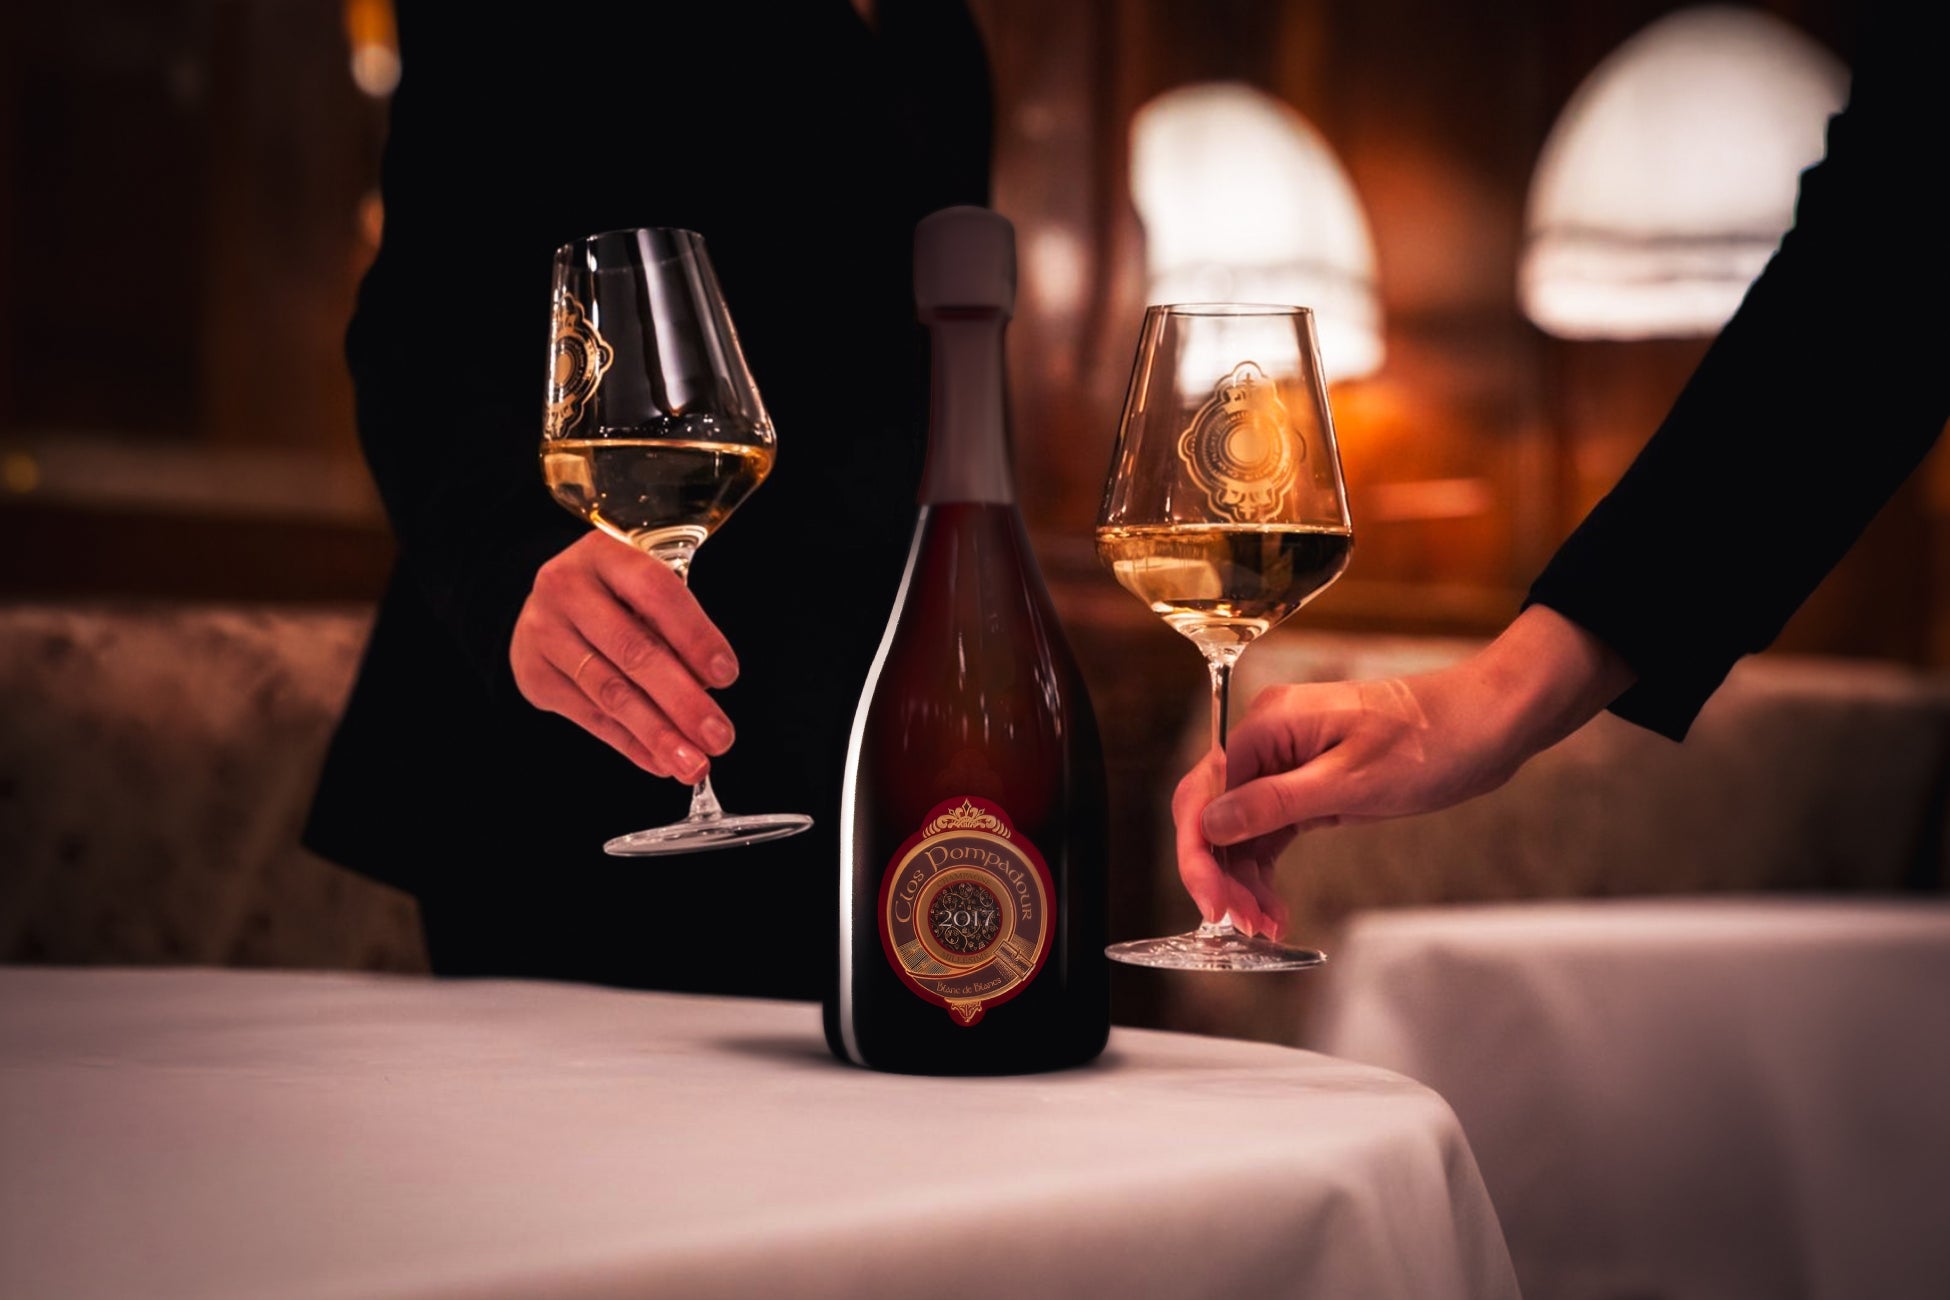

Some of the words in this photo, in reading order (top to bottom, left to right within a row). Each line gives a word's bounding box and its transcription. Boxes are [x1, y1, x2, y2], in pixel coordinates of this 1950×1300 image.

[895, 869, 925, 923] Clos
[938, 910, 994, 927] 2017
[937, 981, 961, 994] Blanc
[962, 986, 973, 994] de
